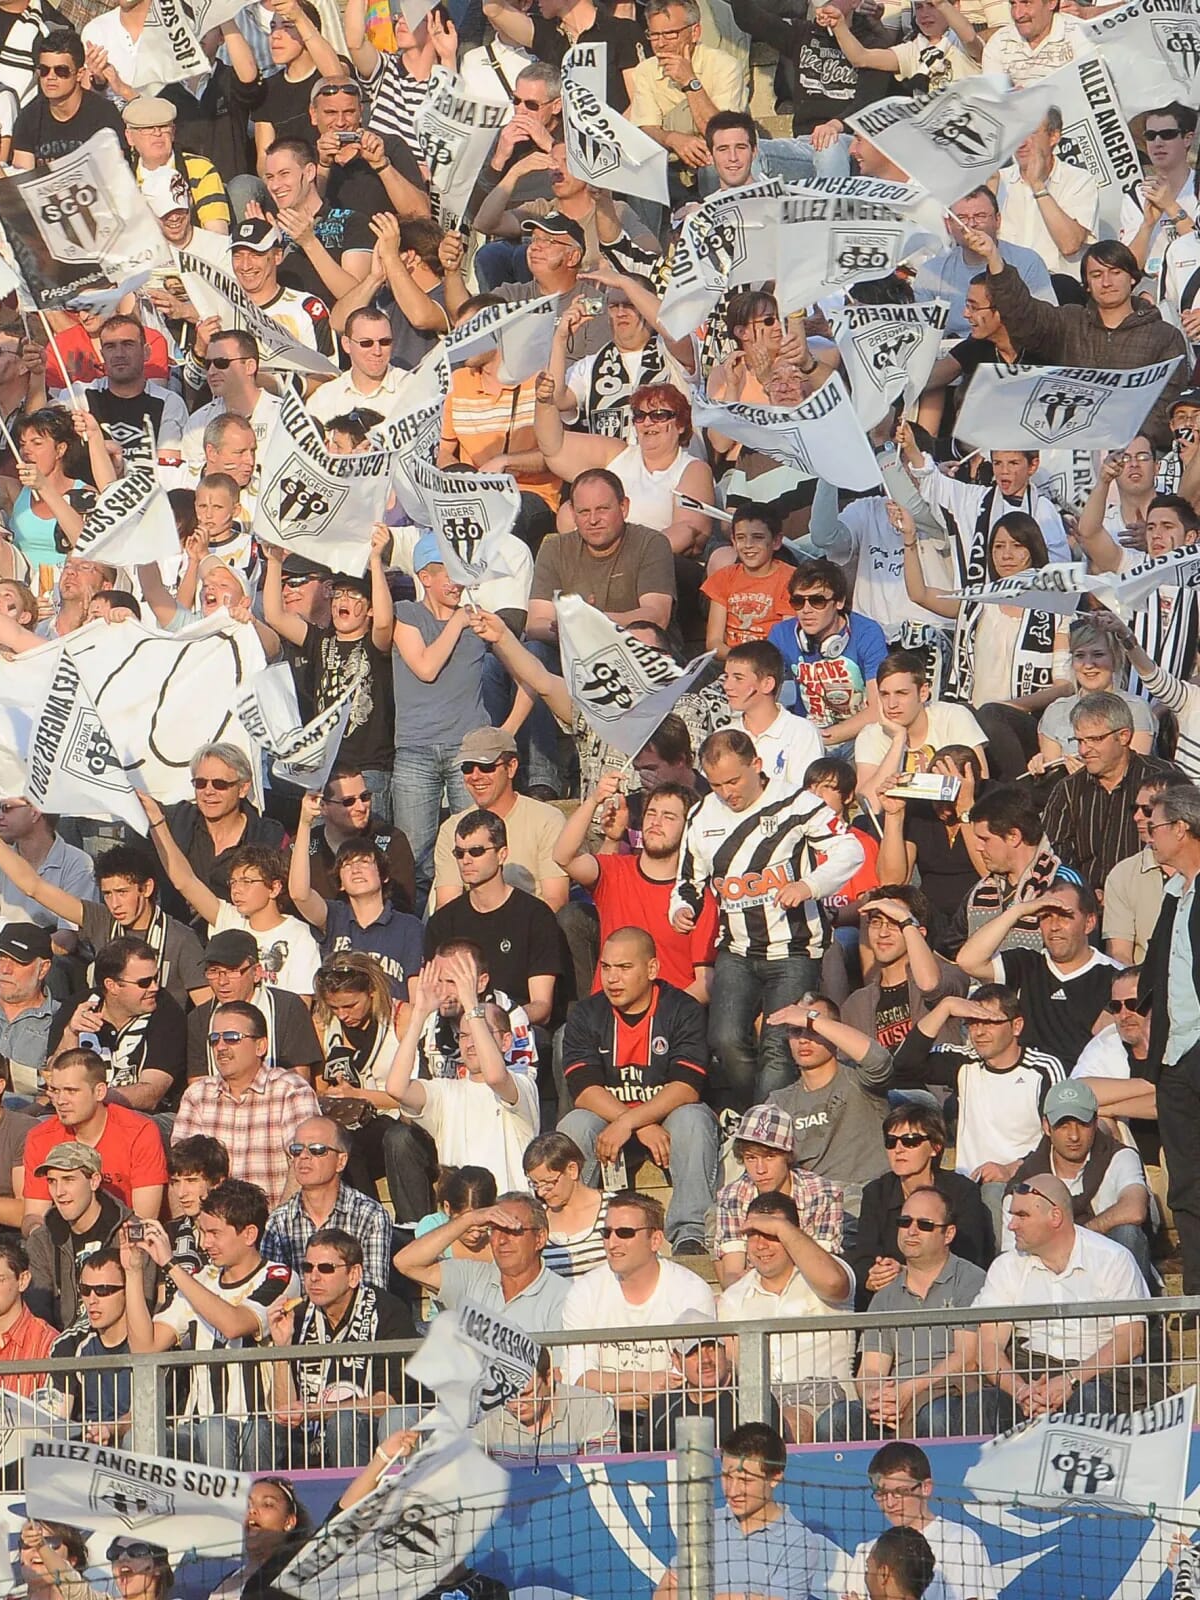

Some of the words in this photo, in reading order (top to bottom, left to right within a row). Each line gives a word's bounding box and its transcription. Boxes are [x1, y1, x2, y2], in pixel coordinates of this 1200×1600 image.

[1078, 58, 1113, 110] ALLEZ
[1077, 134, 1100, 176] ANGERS
[1094, 108, 1139, 181] ANGERS
[43, 187, 97, 222] SCO
[844, 235, 889, 246] ANGERS
[841, 252, 886, 267] SCO
[293, 467, 335, 499] ANGERS
[285, 480, 324, 515] SCO
[440, 506, 476, 518] ANGERS
[444, 524, 480, 540] SCO
[798, 659, 849, 684] HAVE
[619, 1065, 644, 1084] Fly
[604, 1081, 667, 1105] mirate
[794, 1111, 830, 1131] STAR
[32, 1441, 90, 1462] ALLEZ
[95, 1451, 177, 1489] ANGERS
[109, 1479, 158, 1500] ANGERS
